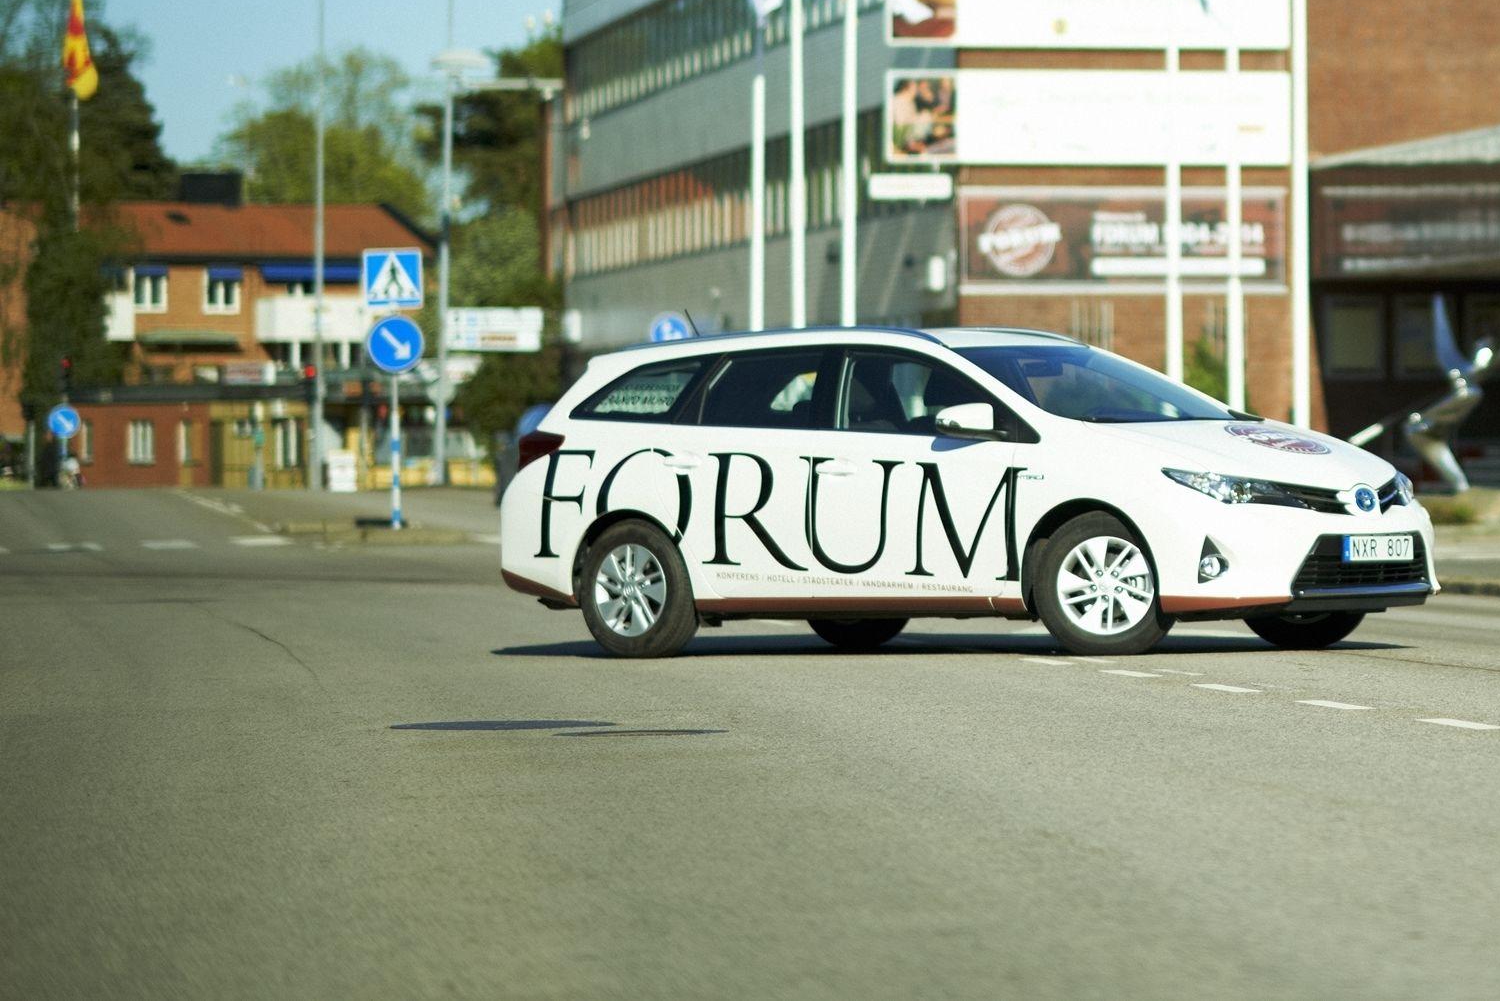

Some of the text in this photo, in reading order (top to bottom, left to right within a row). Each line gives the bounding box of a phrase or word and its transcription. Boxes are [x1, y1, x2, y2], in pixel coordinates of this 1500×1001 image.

[533, 447, 1029, 582] FORUM
[1352, 538, 1410, 558] NXR 807
[716, 571, 760, 582] KONFERENS
[767, 575, 795, 583] HOTELL
[921, 582, 974, 593] RESTAURANG
